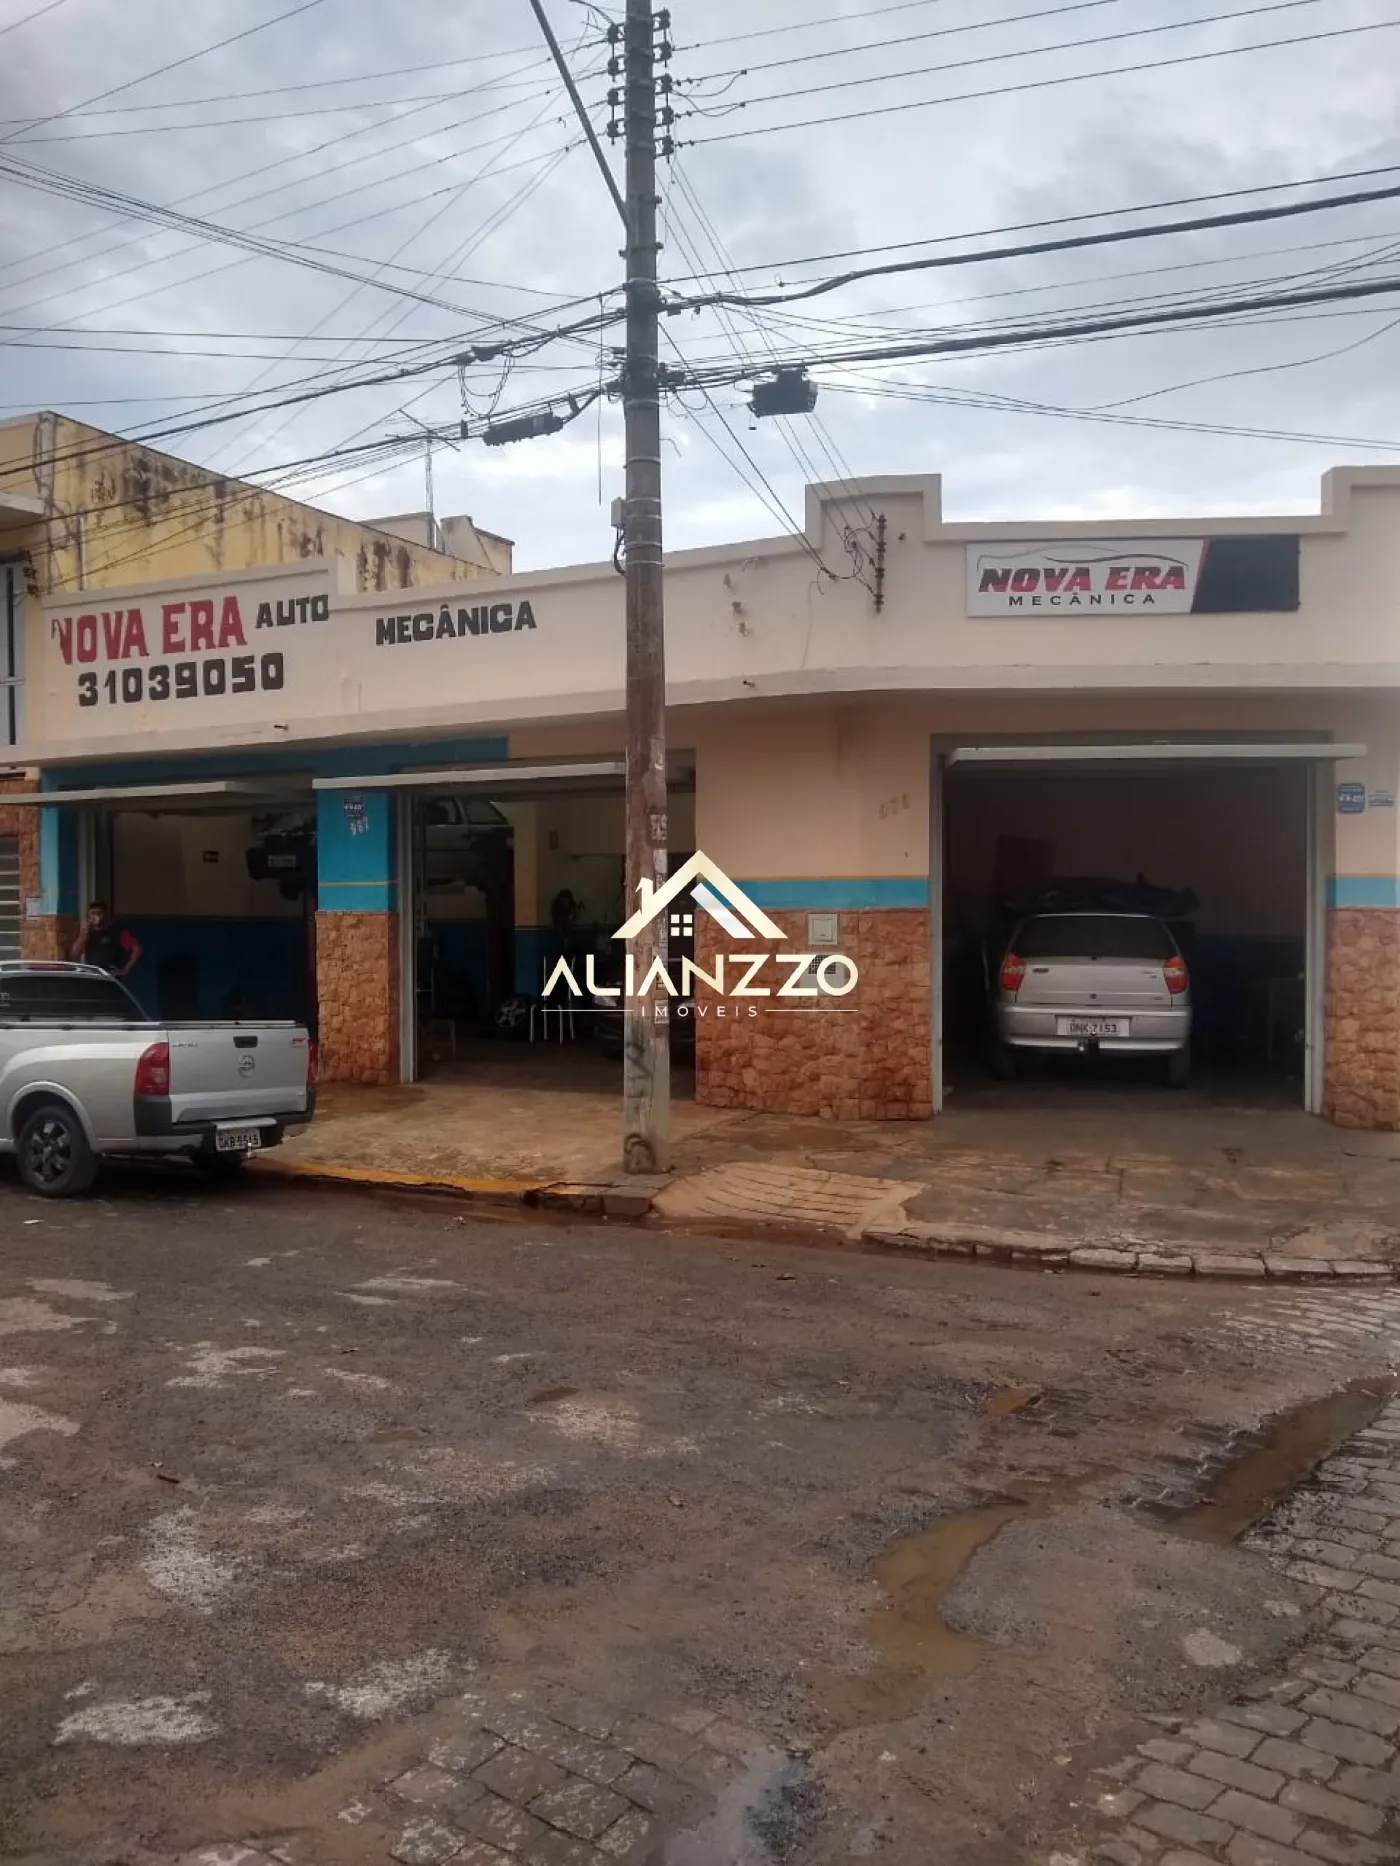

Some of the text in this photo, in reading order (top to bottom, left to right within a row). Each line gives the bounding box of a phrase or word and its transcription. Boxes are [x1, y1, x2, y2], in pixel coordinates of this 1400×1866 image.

[978, 565, 1187, 593] NOVA ERA
[1008, 592, 1156, 606] MECÂNICA
[51, 594, 537, 666] NOVA ERA AUTO MECÂNICA
[78, 652, 285, 707] 31039050
